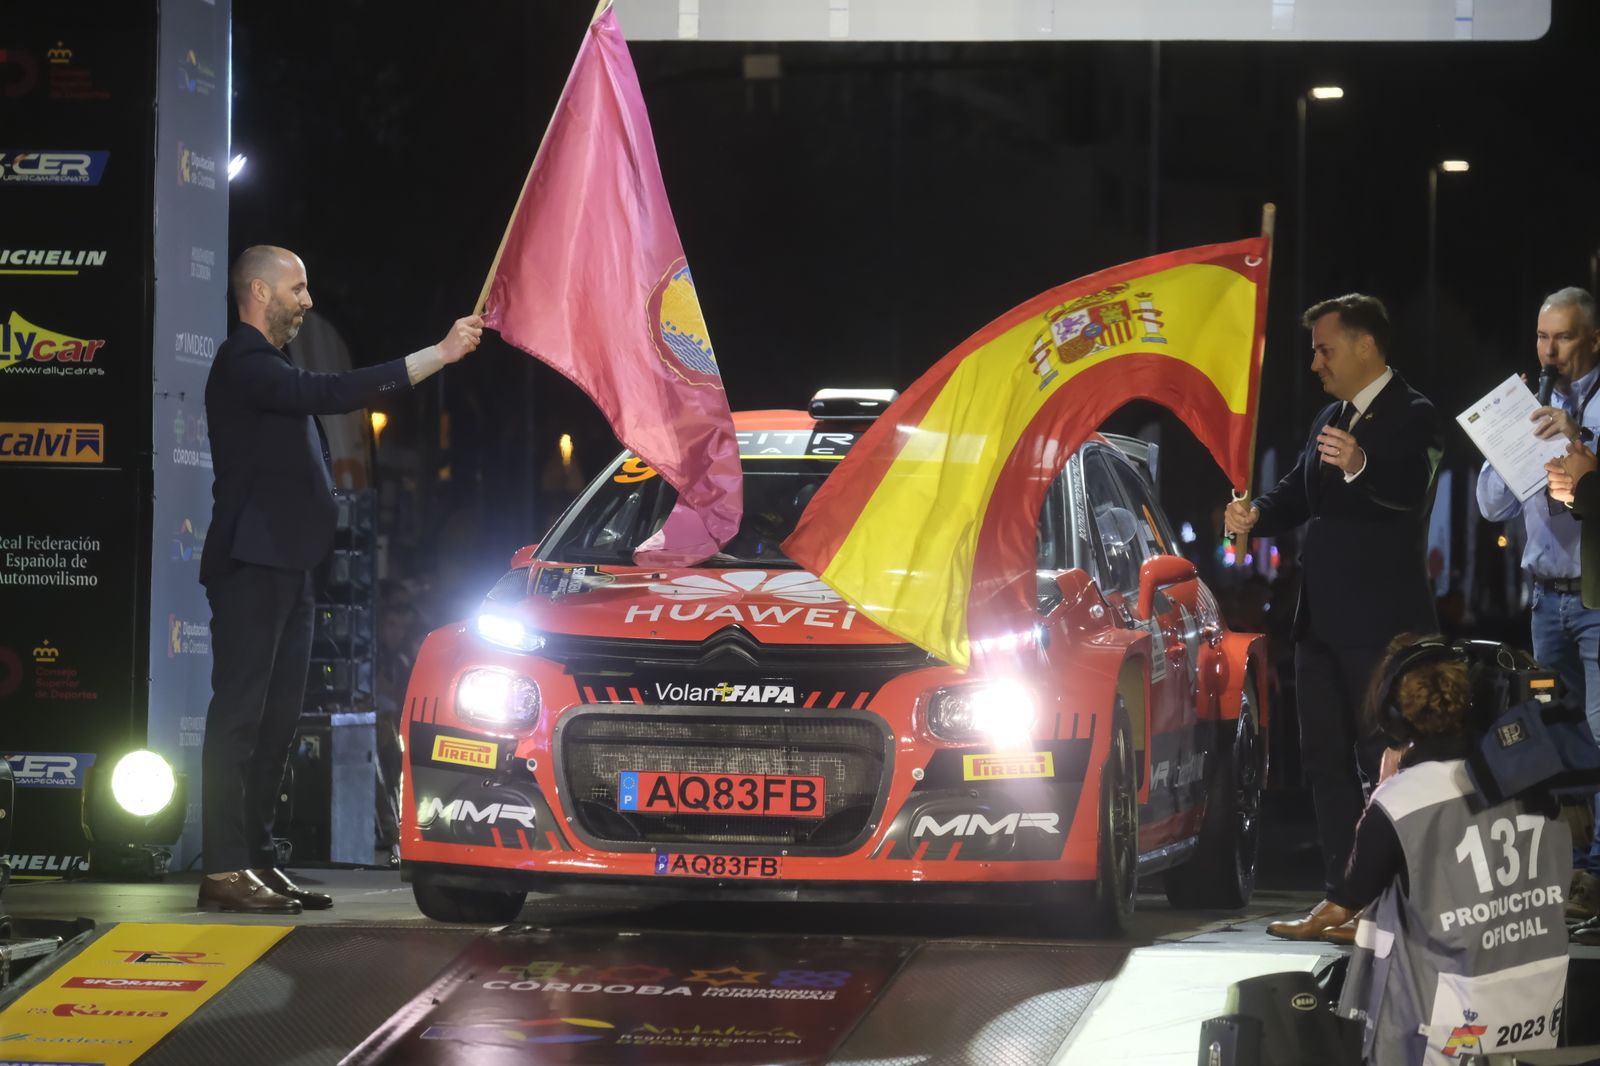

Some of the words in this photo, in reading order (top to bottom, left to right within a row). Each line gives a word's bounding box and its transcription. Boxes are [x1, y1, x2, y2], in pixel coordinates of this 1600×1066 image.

[0, 250, 107, 265] ICHELIN
[0, 323, 105, 362] lycar
[4, 366, 105, 376] www.rallycar.es
[27, 535, 101, 551] Federación
[6, 553, 67, 571] Española
[71, 553, 88, 568] de
[624, 604, 856, 630] HUAWEI
[438, 739, 492, 764] PIRELLI
[972, 755, 1046, 777] PIRELLI
[624, 795, 632, 804] P
[645, 775, 818, 811] AQ83FB
[417, 797, 536, 828] MMR
[912, 812, 1060, 837] MMR
[671, 854, 778, 876] AQ83FB
[1456, 814, 1545, 894] 137
[1440, 885, 1565, 932] PRODUCTOR
[1482, 916, 1549, 950] OFICIAL
[82, 978, 185, 987] SPORMEX
[1496, 1015, 1546, 1047] 2023
